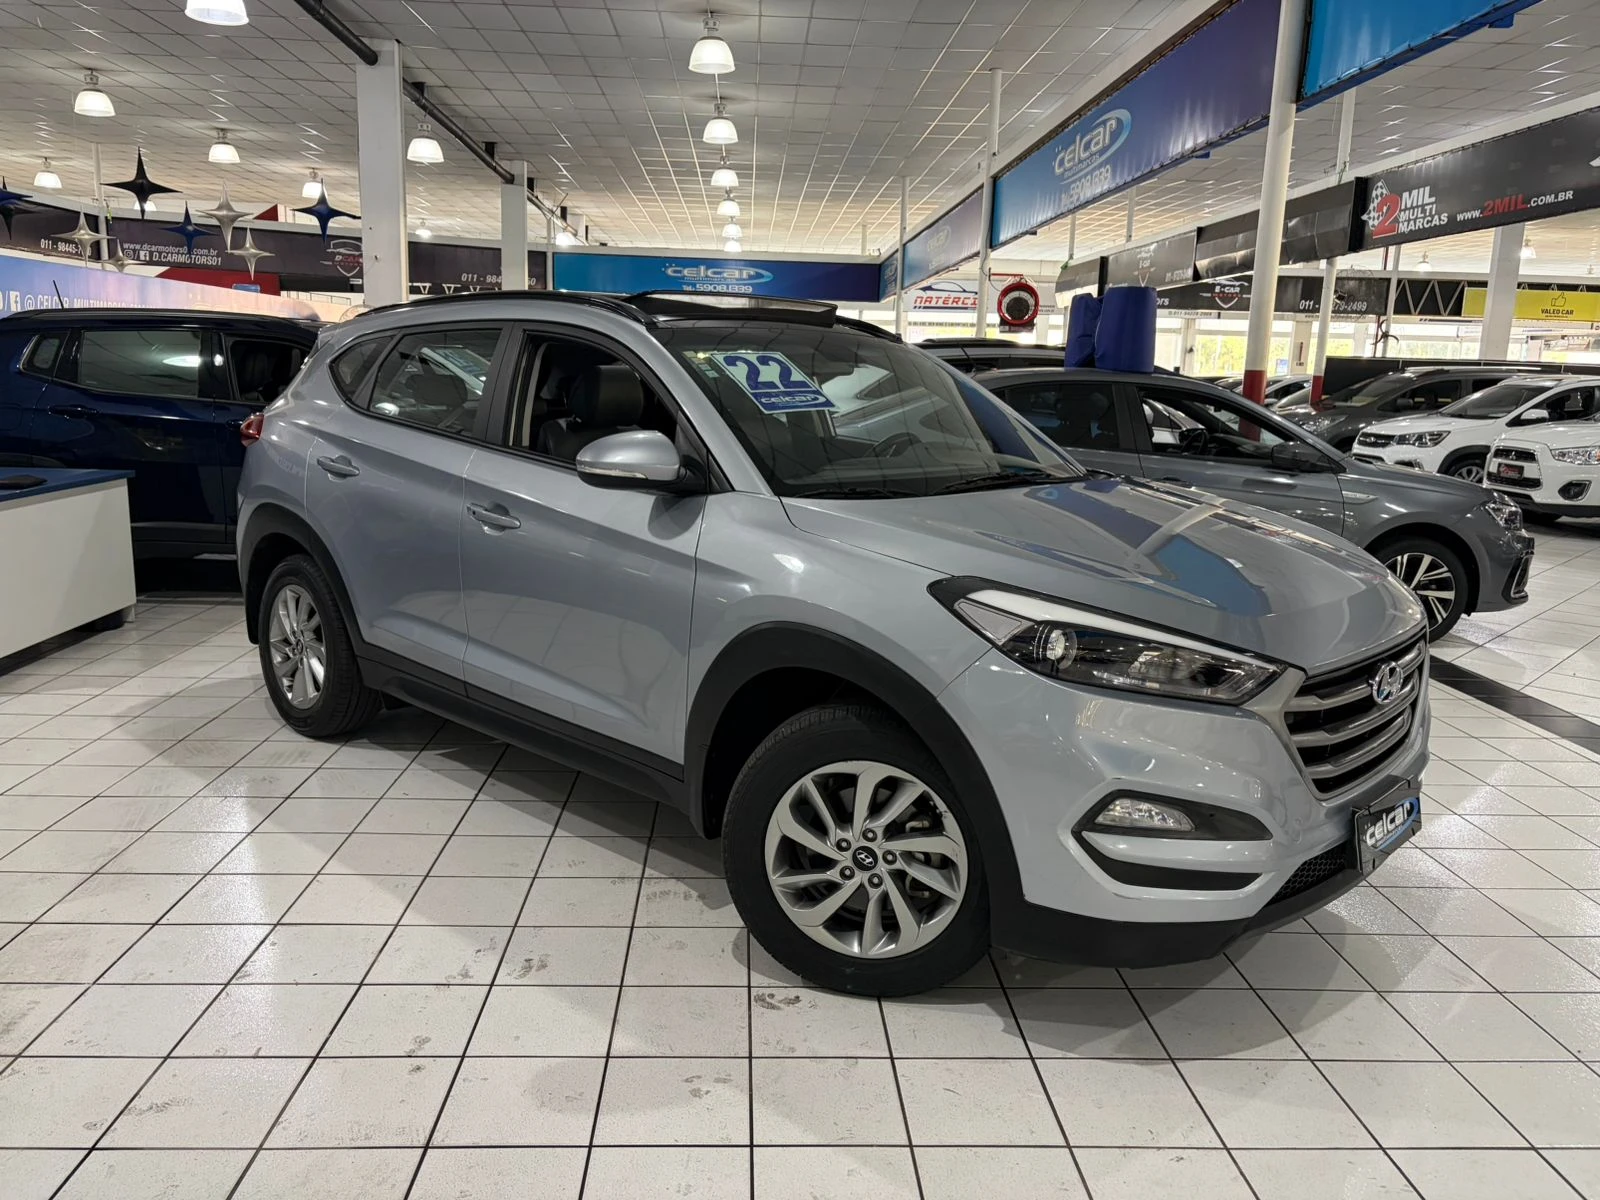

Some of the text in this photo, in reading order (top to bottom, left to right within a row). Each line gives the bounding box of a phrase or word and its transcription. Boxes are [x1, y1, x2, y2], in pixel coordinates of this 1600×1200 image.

[1054, 117, 1118, 177] celcar
[1401, 185, 1437, 210] MIL
[1372, 193, 1401, 238] 2
[1398, 204, 1437, 222] MULTI
[1397, 213, 1449, 235] MARCAS
[40, 238, 52, 249] 011
[122, 242, 218, 256] www.dcarmotors0.com.br
[461, 273, 477, 283] 011
[664, 264, 757, 279] celcar
[1299, 299, 1314, 310] 011
[1560, 308, 1575, 316] CAR
[722, 355, 815, 390] 22
[760, 395, 816, 405] celcar
[1366, 800, 1412, 847] celcar
